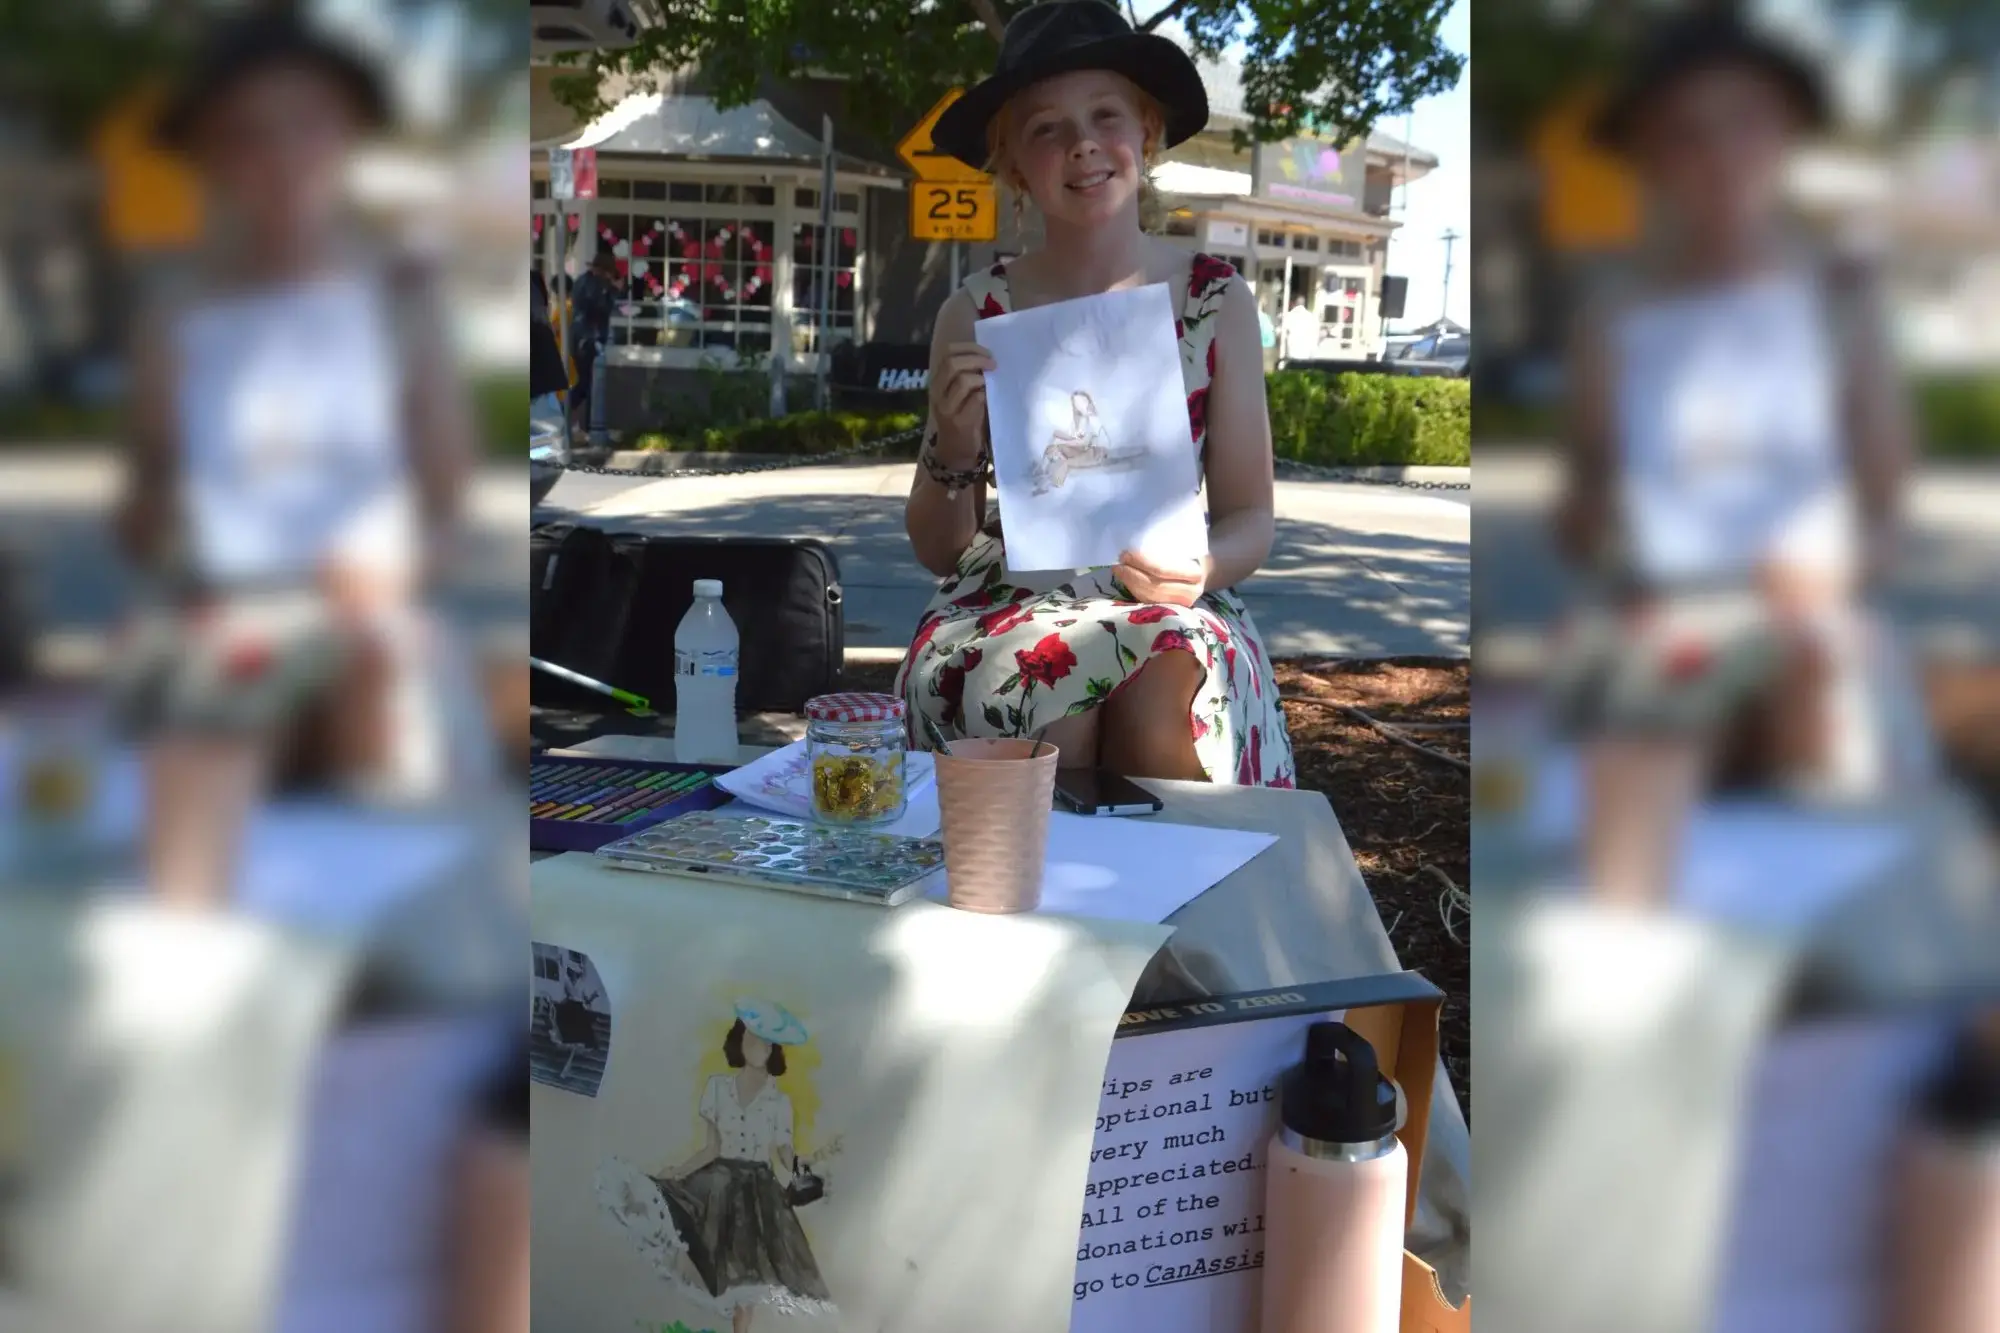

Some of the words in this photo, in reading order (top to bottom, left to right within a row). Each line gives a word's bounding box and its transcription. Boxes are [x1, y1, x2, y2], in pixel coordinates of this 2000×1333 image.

[928, 188, 978, 219] 25
[878, 368, 930, 390] HAH
[1118, 1008, 1182, 1026] OVE
[1184, 1002, 1226, 1016] TO
[1231, 991, 1307, 1012] ZERO
[1102, 1078, 1154, 1099] ips
[1168, 1067, 1214, 1086] are
[1095, 1093, 1213, 1133] optional
[1228, 1085, 1275, 1107] but
[1090, 1140, 1149, 1163] very
[1163, 1125, 1226, 1150] much
[1080, 1206, 1125, 1229] All
[1136, 1198, 1168, 1219] of
[1176, 1194, 1221, 1213] the
[1076, 1227, 1214, 1262] donations
[1223, 1215, 1267, 1237] wil
[1073, 1279, 1105, 1300] go
[1110, 1272, 1140, 1290] to
[1144, 1249, 1266, 1288] CanAssis
